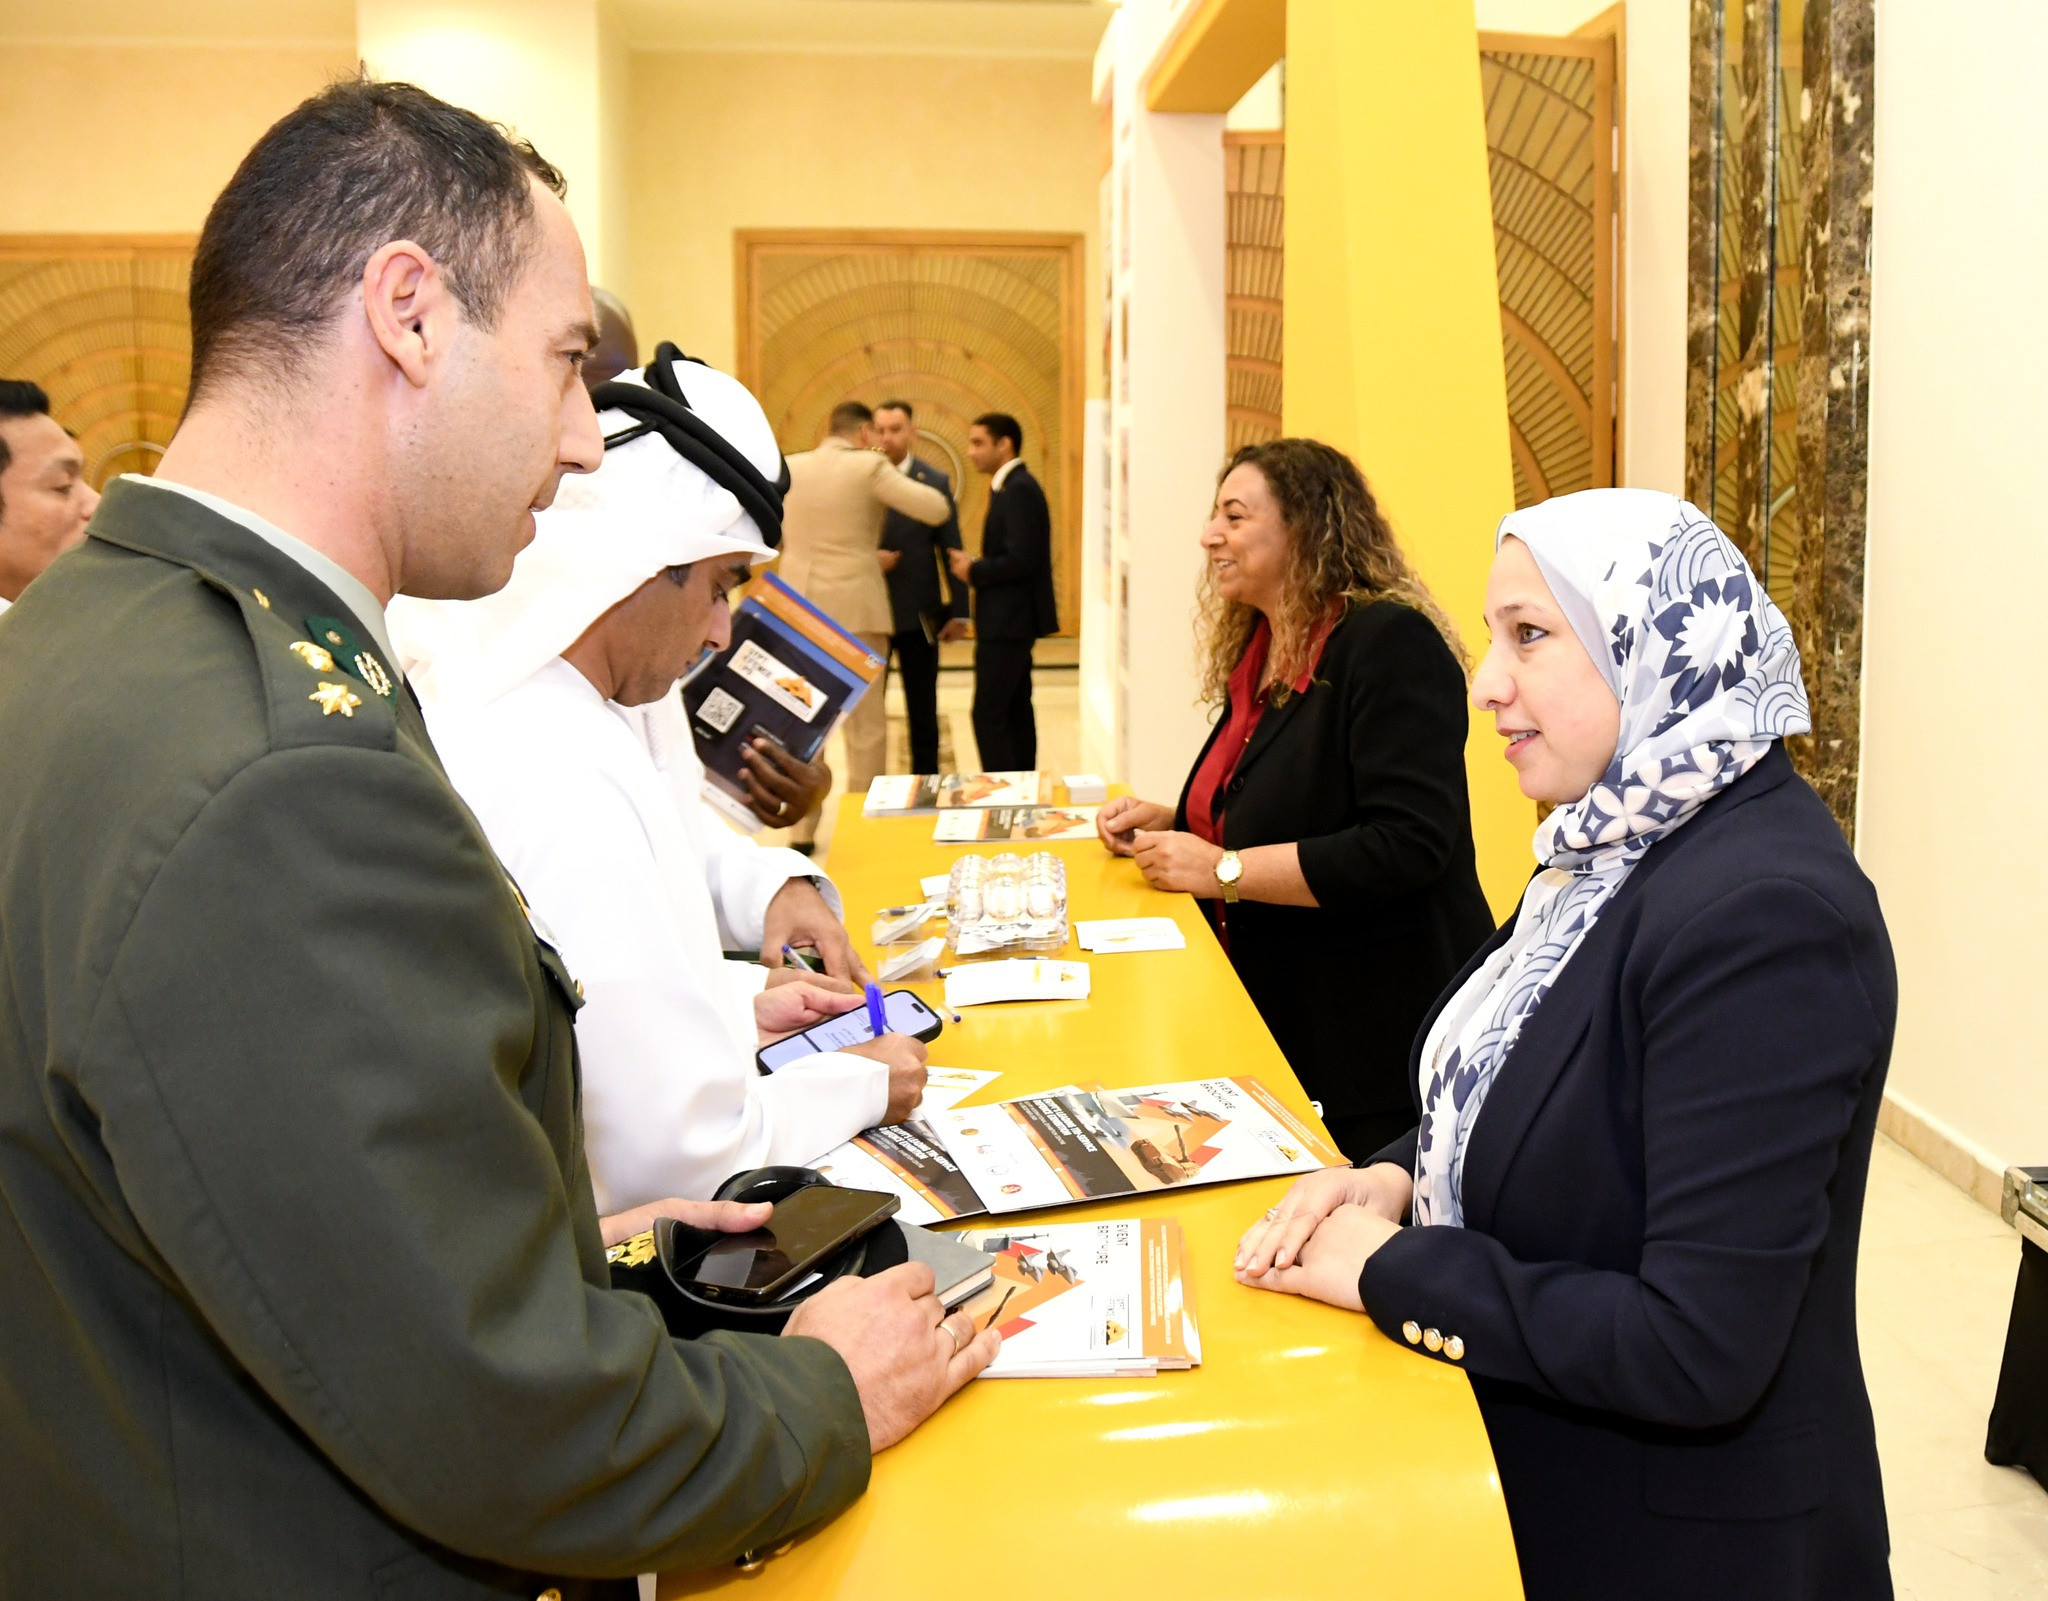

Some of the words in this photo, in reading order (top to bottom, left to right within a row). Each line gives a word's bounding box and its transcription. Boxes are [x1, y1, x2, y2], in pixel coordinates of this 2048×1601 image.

[1199, 1083, 1236, 1109] BROCHURE
[1214, 1081, 1239, 1097] EVENT
[1116, 1224, 1129, 1246] EVENT
